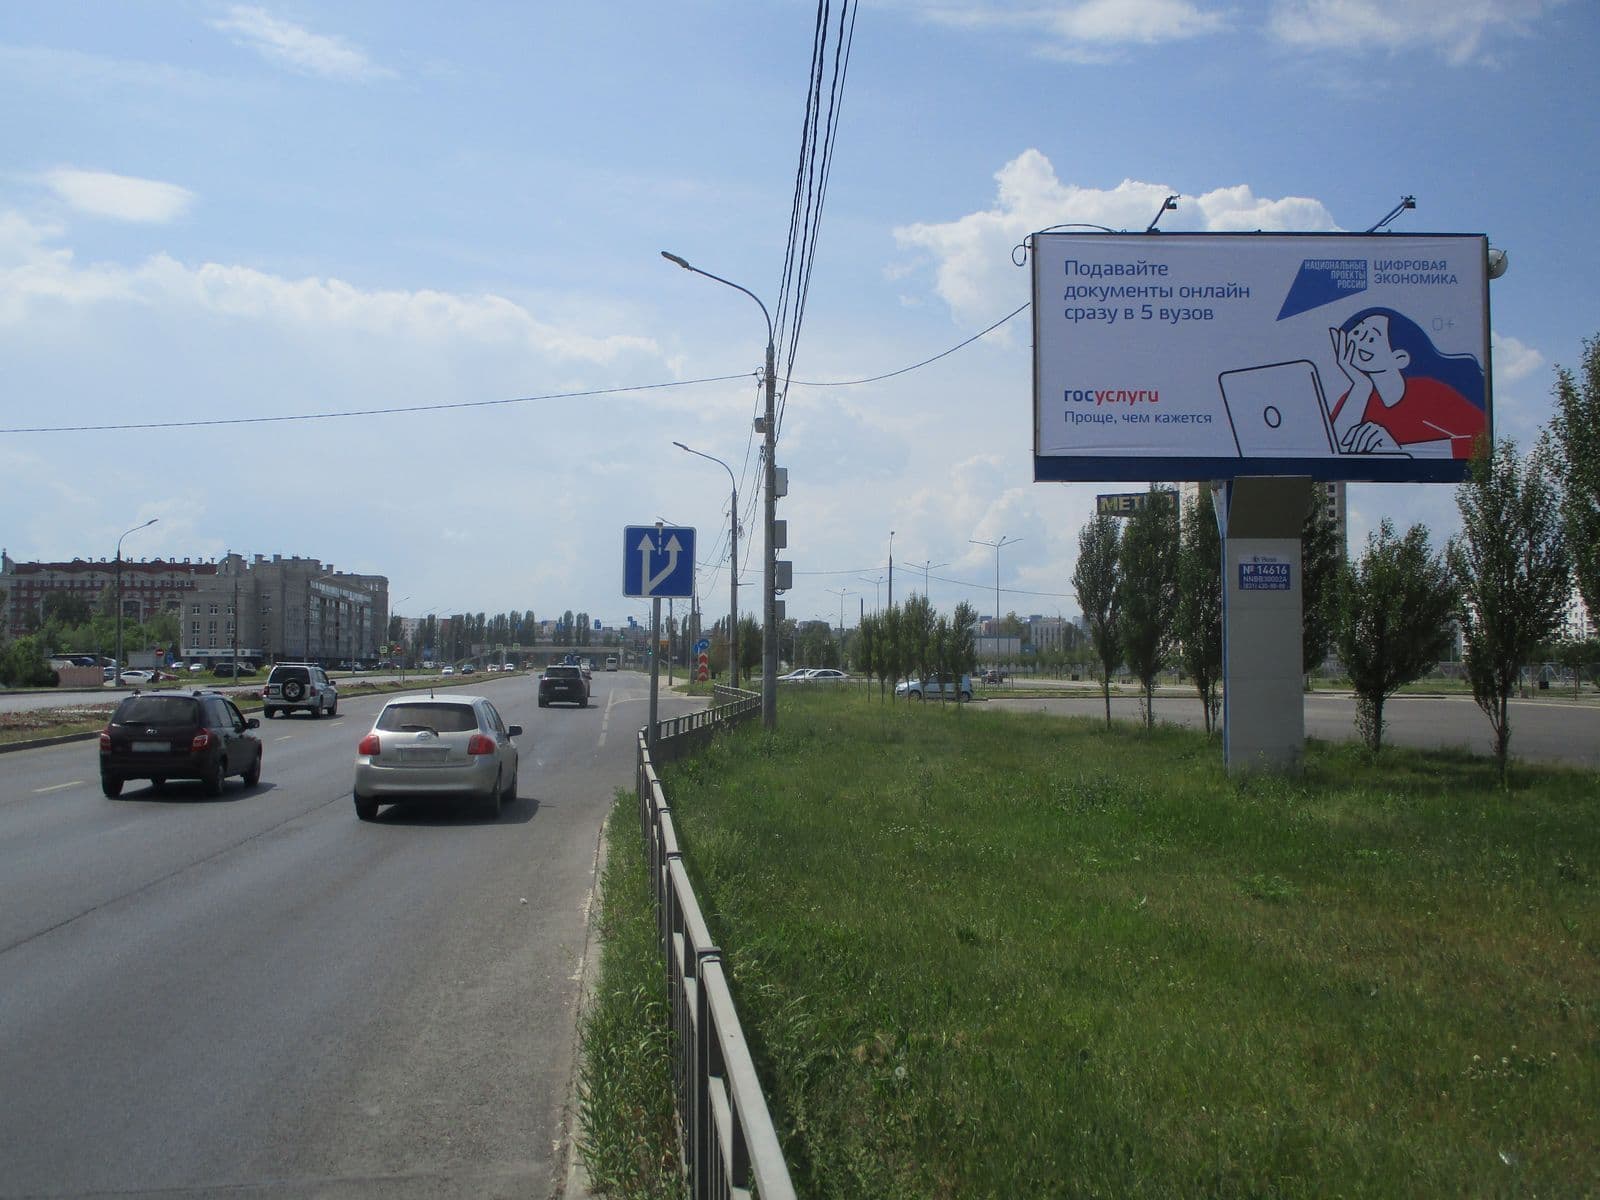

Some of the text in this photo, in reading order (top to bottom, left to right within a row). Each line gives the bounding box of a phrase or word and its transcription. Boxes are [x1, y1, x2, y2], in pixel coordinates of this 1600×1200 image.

[1064, 260, 1169, 279] Подавайте
[1305, 260, 1366, 270] НАЦИОНАЛЬНЫЕ
[1374, 260, 1447, 273] ЦИФРОВАЯ
[1330, 271, 1366, 280] ПРОЕКТЫ
[1374, 273, 1457, 285] ЭКОНОМИКА
[1338, 280, 1366, 289] РОССИИ
[1064, 282, 1250, 302] документы онлайн
[1064, 304, 1214, 324] сразу в 5 вузов
[1431, 317, 1455, 332] 0+
[1064, 390, 1159, 406] госуслуги
[1064, 411, 1212, 425] Проще, чем кажется
[1257, 565, 1288, 575] 14616
